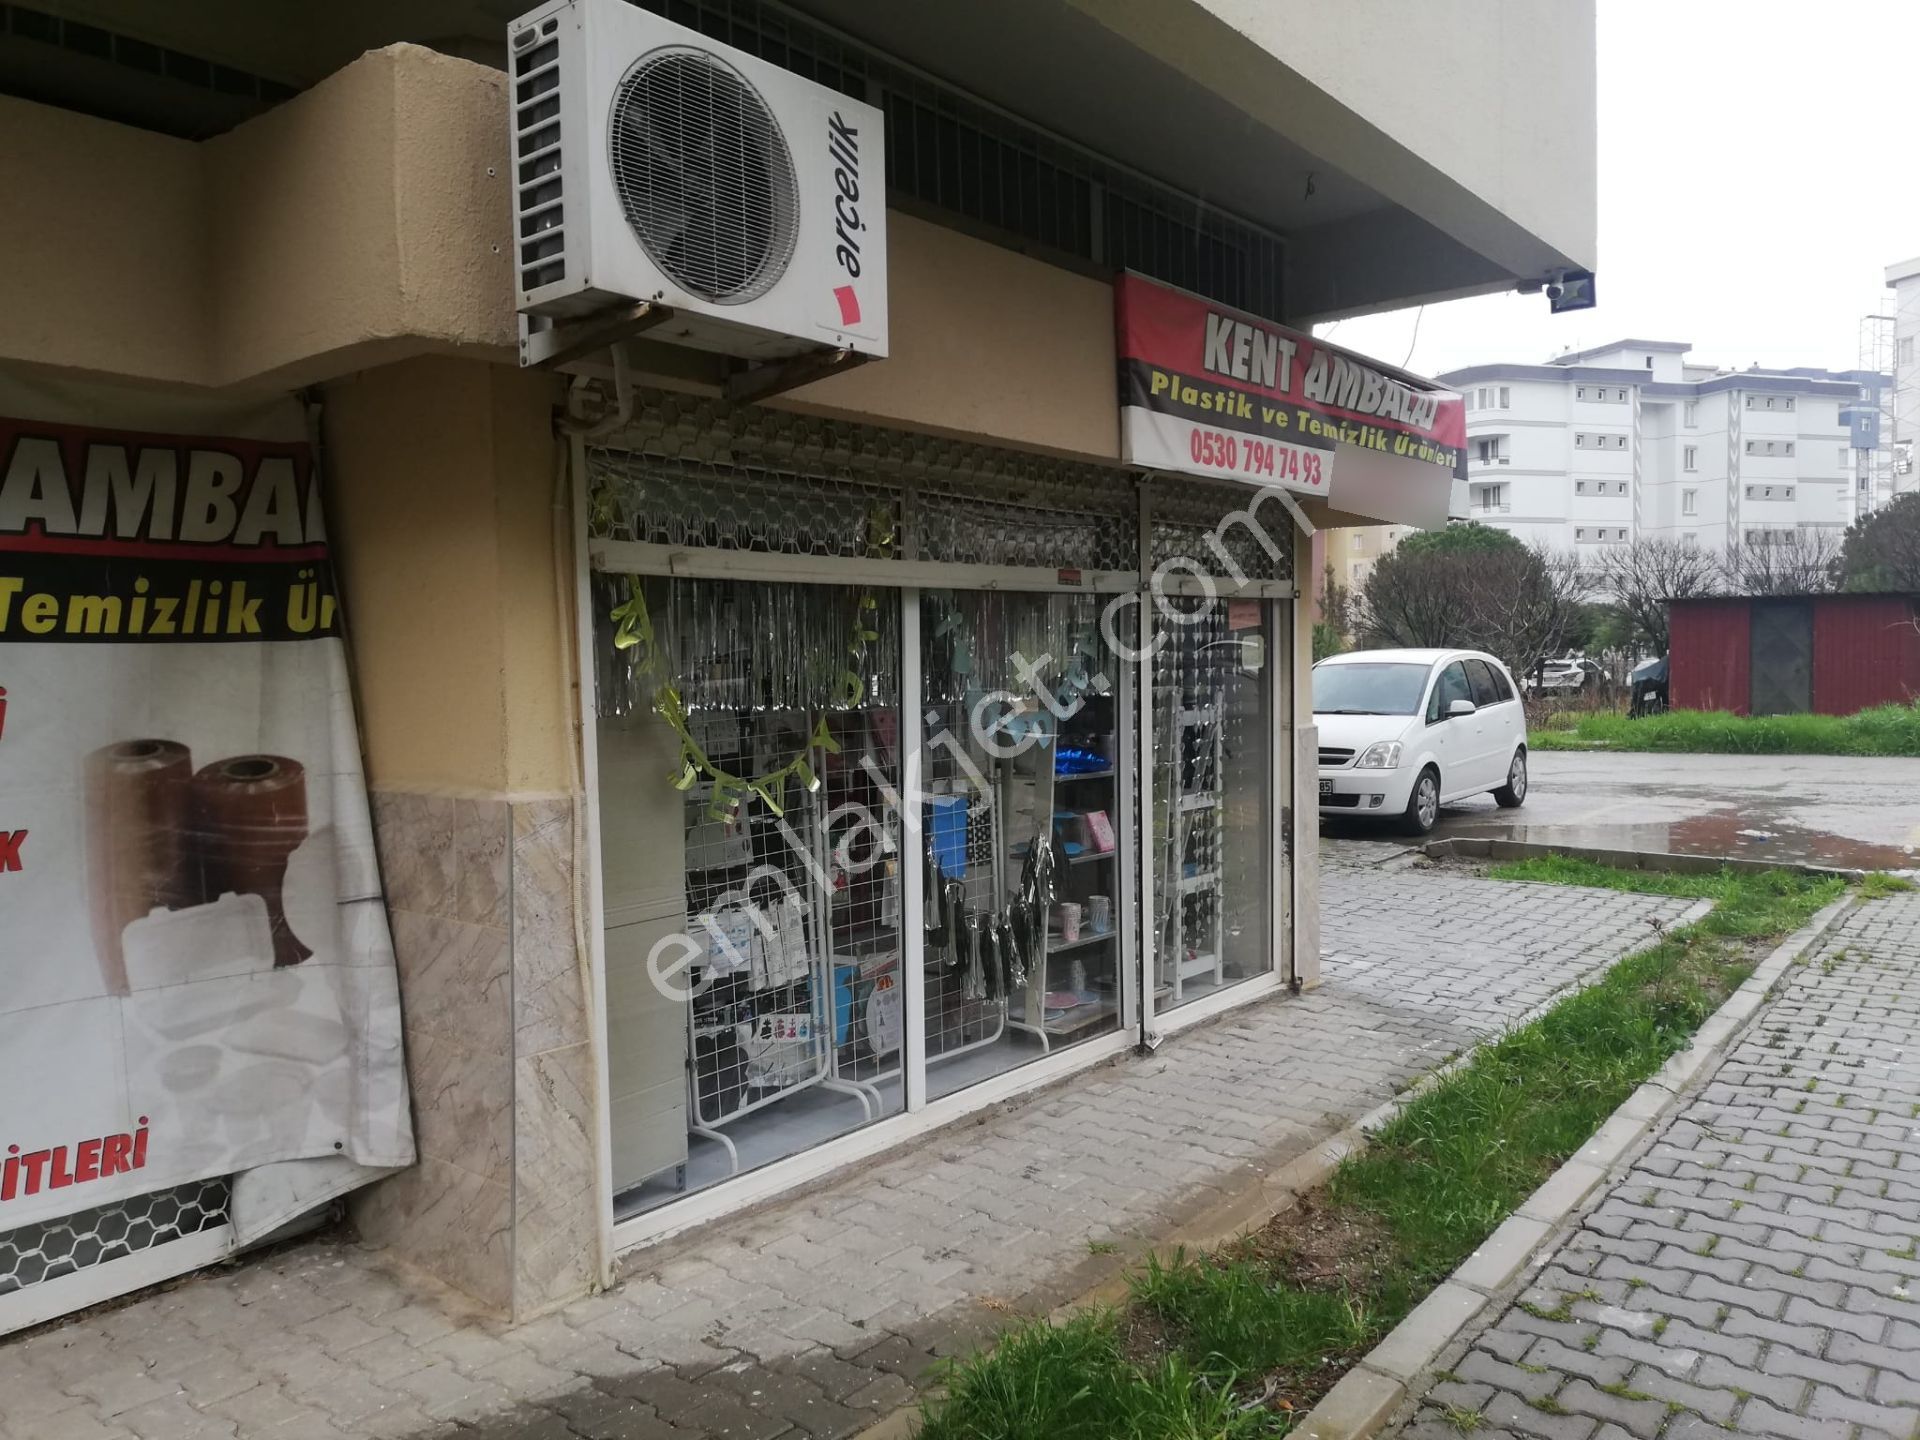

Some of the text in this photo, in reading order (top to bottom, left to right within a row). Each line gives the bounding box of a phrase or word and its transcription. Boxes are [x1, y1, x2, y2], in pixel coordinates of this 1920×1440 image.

[828, 111, 866, 278] arçelik
[1151, 371, 1457, 469] Plastik ve Temizlik Ürünleri
[1204, 312, 1439, 431] KENT AMBALAJ
[1191, 428, 1322, 486] 0530 794 74 93
[0, 575, 263, 635] Temizlik
